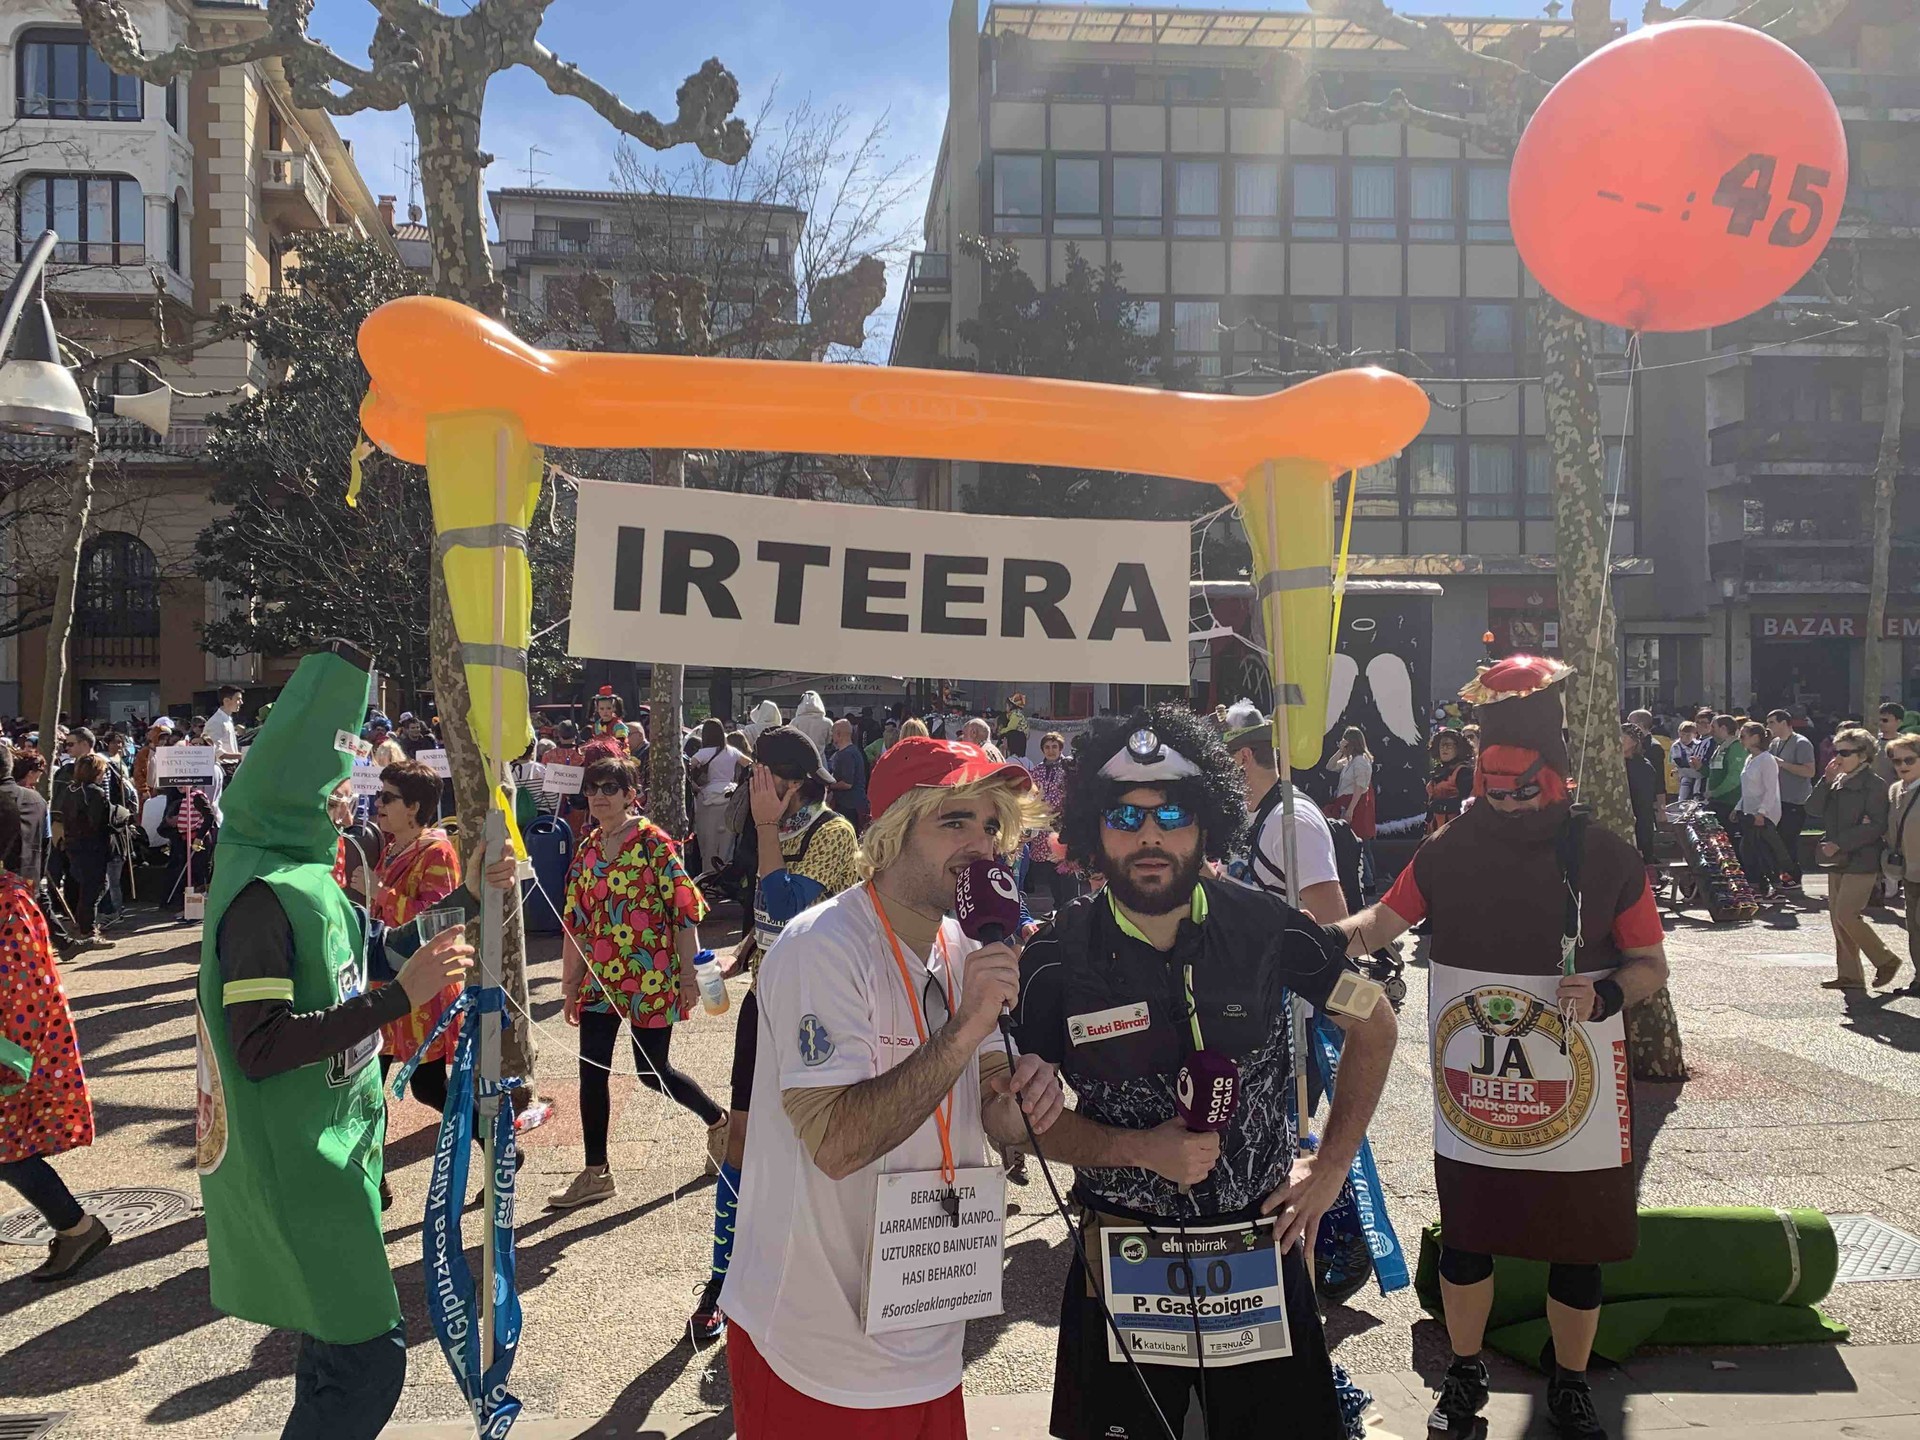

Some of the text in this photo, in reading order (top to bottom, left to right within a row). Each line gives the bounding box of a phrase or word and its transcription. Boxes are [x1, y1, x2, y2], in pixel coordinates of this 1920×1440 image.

[612, 525, 1172, 643] IRTEERA
[1763, 617, 1855, 636] BAZAR
[1086, 1021, 1113, 1037] Eutsi
[1469, 1034, 1535, 1080] JA
[1207, 1077, 1225, 1124] ataria
[1218, 1077, 1233, 1123] irratia
[1466, 1121, 1494, 1143] THE
[1499, 1125, 1560, 1145] AMSTEL
[1560, 1050, 1591, 1127] TRADITION
[1471, 1078, 1538, 1103] BEER
[1612, 1046, 1630, 1149] GENUINE
[1491, 1112, 1518, 1124] 2019
[430, 1114, 469, 1341] Gipuzkoa Kirolak
[961, 1210, 1001, 1226] KANPO...
[881, 1235, 998, 1262] UZTURREKO BAINUETAN
[902, 1262, 977, 1286] HASI BEHARKO!
[881, 1289, 993, 1319] #Sorosleaklangabezian
[1133, 1295, 1263, 1317] P. Gascoigne
[1209, 1339, 1244, 1351] TERNUA
